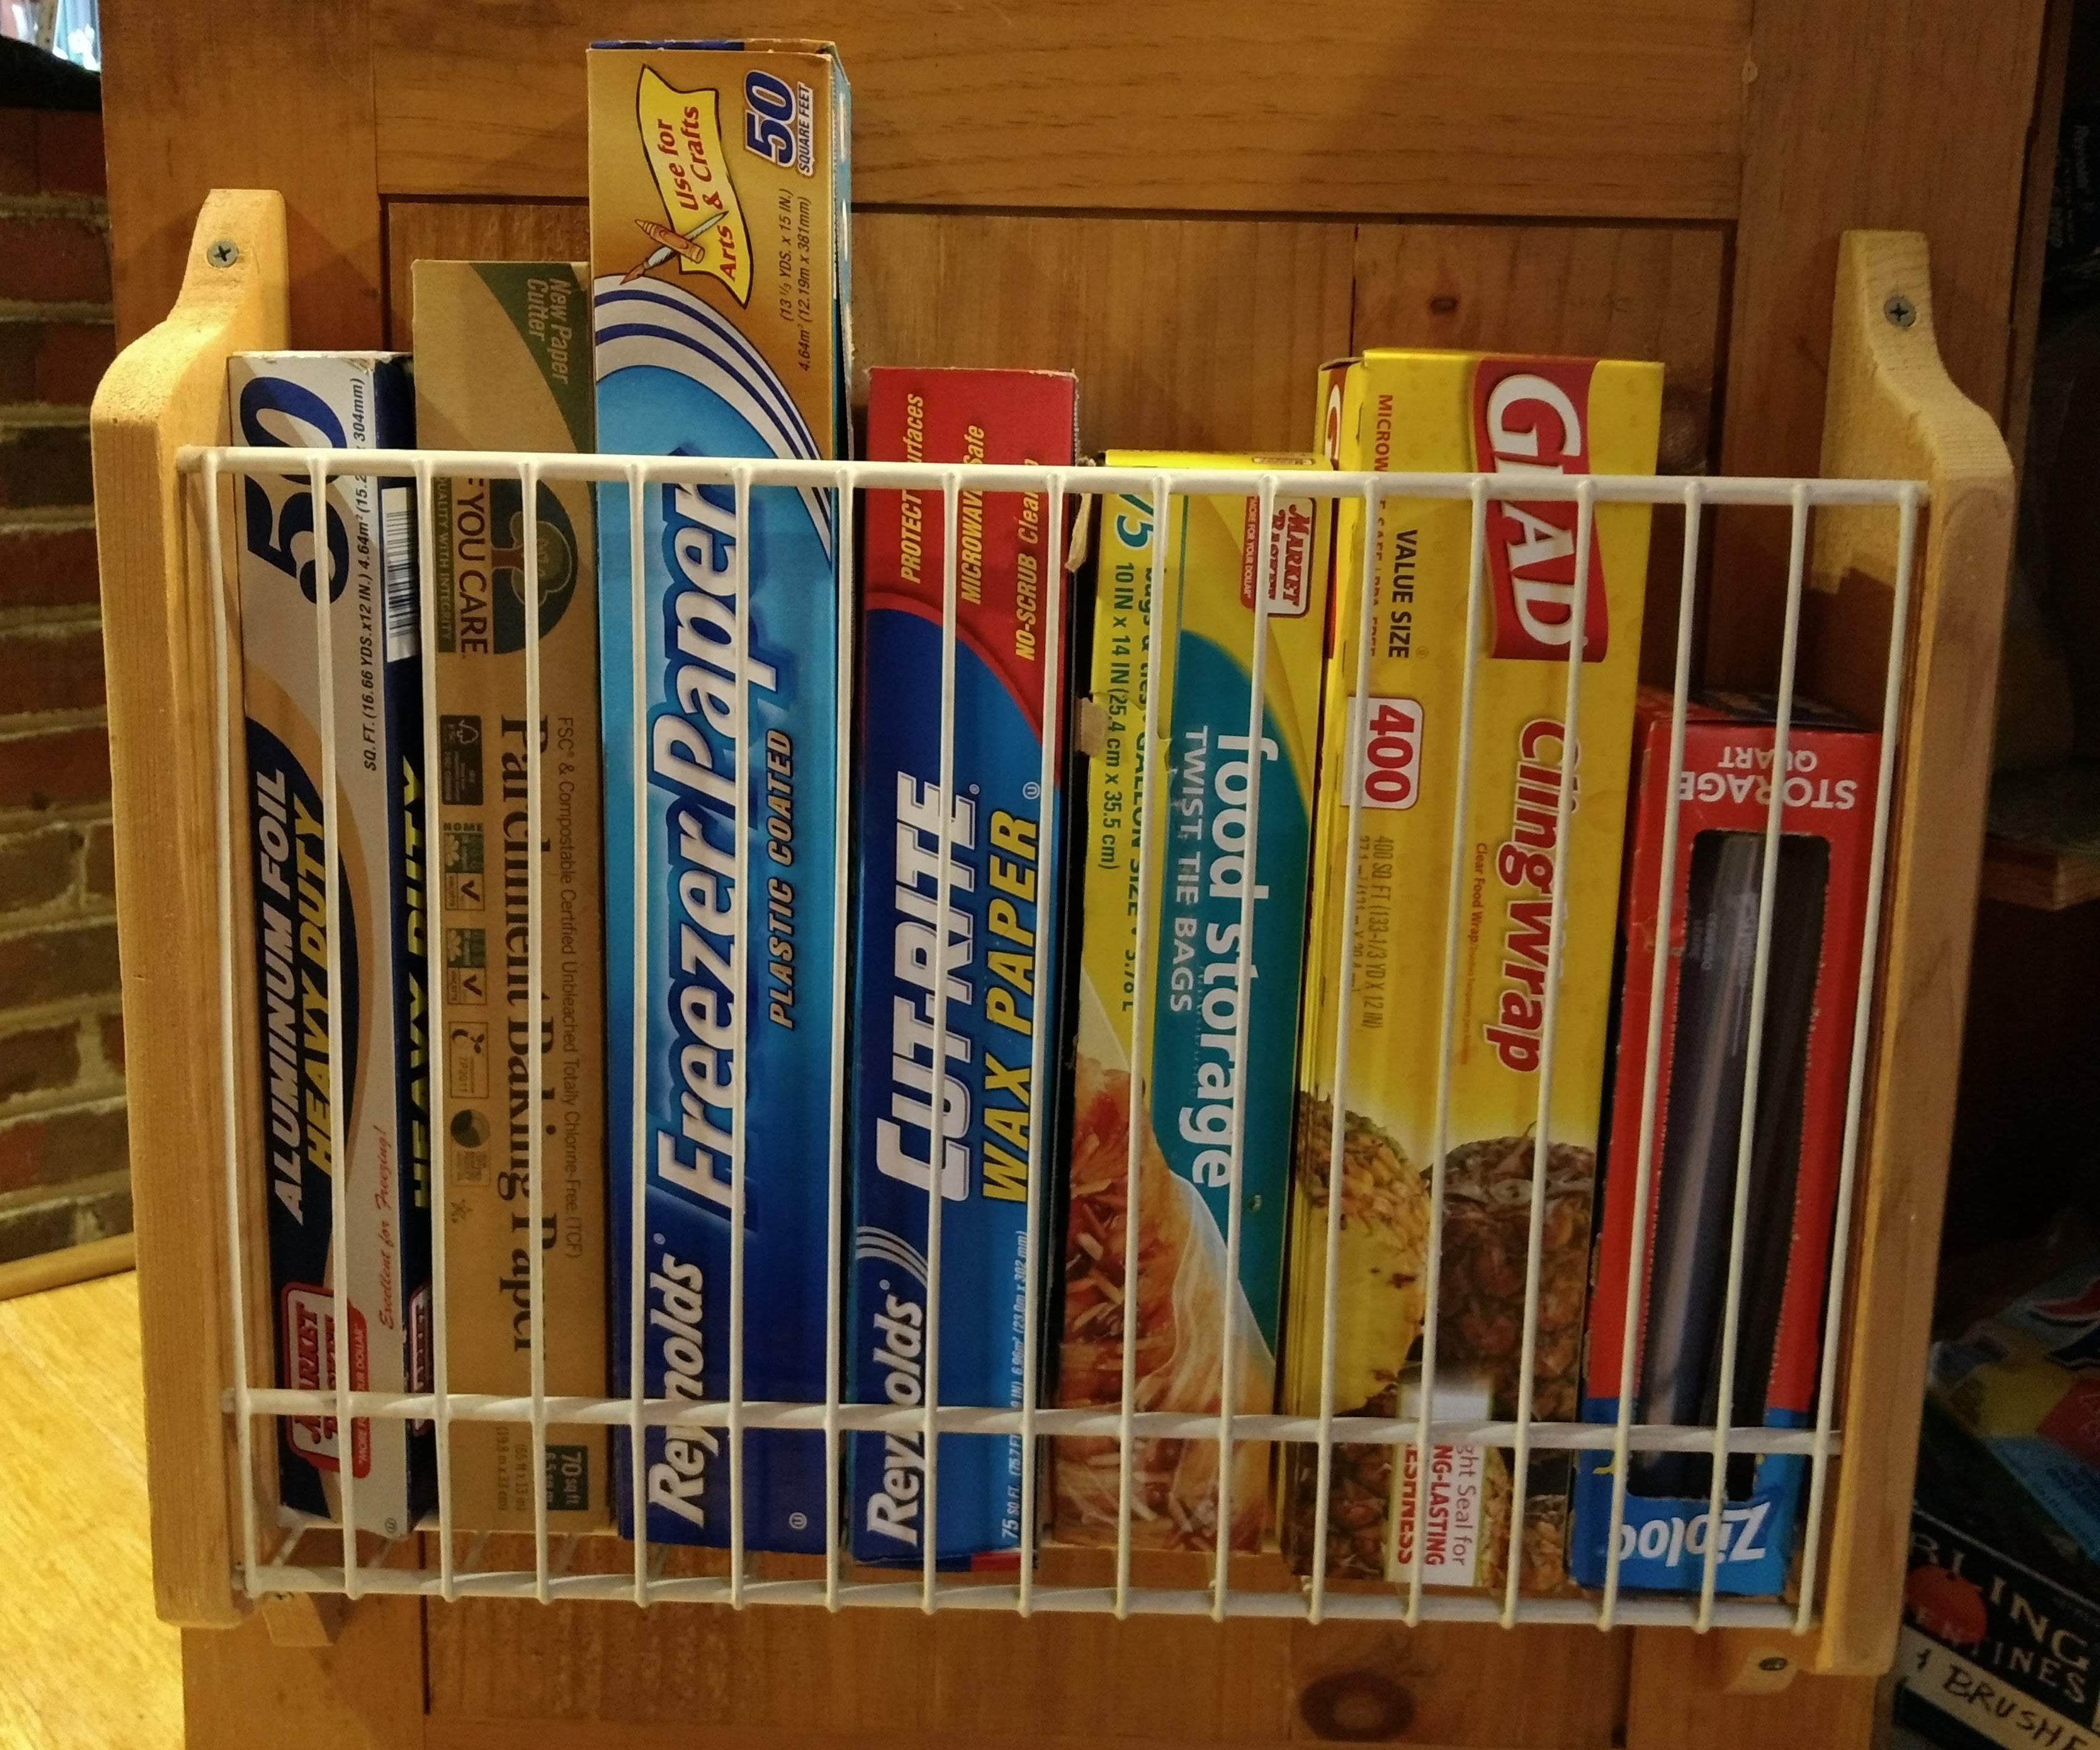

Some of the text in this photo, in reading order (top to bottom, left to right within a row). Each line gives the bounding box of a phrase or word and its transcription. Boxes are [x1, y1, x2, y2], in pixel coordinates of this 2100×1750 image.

[744, 70, 797, 168] 50
[798, 84, 814, 176] SQUARE FEET
[657, 118, 700, 211] Use for
[683, 105, 737, 282] Arts & Crafts
[778, 189, 793, 211] IN.)
[780, 217, 791, 231] 15
[797, 197, 811, 252] 381mm)
[779, 250, 791, 278] YDS.
[800, 255, 809, 264] x
[526, 280, 546, 341] Cutter
[780, 299, 793, 321] (13
[798, 269, 812, 322] (12.19m
[550, 279, 572, 385] New Paper
[350, 378, 366, 442] 304mm)
[964, 425, 985, 465] Safe
[239, 376, 349, 605] 50
[901, 394, 924, 583] PROTECT urfaces
[1487, 374, 1584, 648] GLAD
[439, 531, 450, 568] WITH
[457, 493, 486, 561] YOU
[1245, 542, 1254, 564] YOUR
[1246, 524, 1255, 540] FOR
[1283, 504, 1310, 606] MARKET
[357, 574, 372, 601] IN.)
[441, 573, 451, 639] INTEGRITY
[459, 570, 488, 654] CARE
[1016, 554, 1035, 661] NO-SCRUB
[1388, 529, 1419, 659] VALUE SIZE
[360, 668, 377, 719] (16.66
[1097, 562, 1134, 871] 10 IN x 14 IN (25.4 cm x 35.5 cm)
[362, 722, 375, 744] FT.
[363, 747, 377, 770] SQ.
[1365, 703, 1415, 802] 400
[558, 762, 575, 775] &
[1678, 770, 1858, 810] STORAGE
[443, 822, 483, 832] HOME
[555, 780, 576, 884] Compostable
[653, 457, 778, 1210] Freezer Paper
[1373, 836, 1394, 858] 400
[1475, 842, 1487, 874] Clear
[766, 729, 795, 1029] PLASTIC COATED
[1170, 726, 1209, 1013] TWIST TIE BAGS
[1371, 863, 1392, 878] SQ
[1371, 885, 1391, 901] FT
[1472, 878, 1485, 907] Food
[559, 889, 578, 955] Certified
[1367, 905, 1390, 959] (133-1/3
[1467, 911, 1483, 943] Wrap
[294, 797, 334, 1176] HEAVY DUTY
[876, 770, 975, 1201] CUT-RITE
[1178, 733, 1280, 1188] food storage
[1366, 964, 1386, 978] YD
[256, 769, 304, 1226] ALUMINUM FOIL
[560, 961, 578, 1052] Unbleached
[982, 809, 1038, 1203] WAX PAPER
[1361, 1012, 1383, 1029] IN)
[1364, 996, 1384, 1007] 12
[560, 1058, 580, 1107] Totally
[562, 1111, 582, 1212] Chlorine-Free
[373, 1125, 394, 1330] Excellent for Freezing!
[563, 1216, 584, 1258] (TCF)
[294, 1302, 321, 1444] MRKET
[648, 1254, 719, 1529] Reynolds
[866, 1294, 925, 1546] Reyolds
[561, 1452, 582, 1504] 70 sq ft
[1398, 1444, 1418, 1564] ESHNESS
[1425, 1446, 1453, 1565] NG-LASTING
[1001, 1518, 1019, 1539] 75
[1453, 1484, 1477, 1565] Seal for
